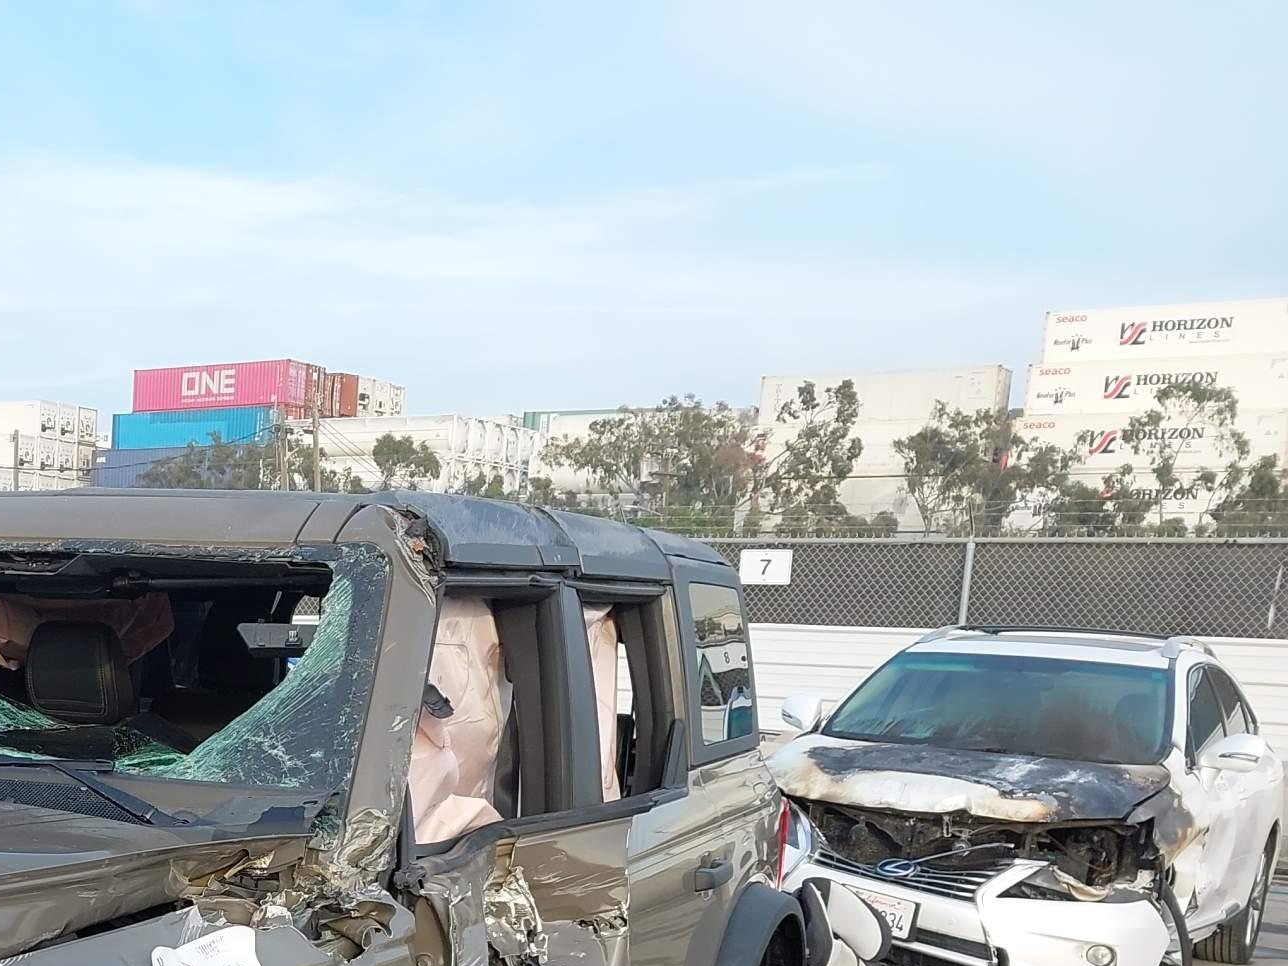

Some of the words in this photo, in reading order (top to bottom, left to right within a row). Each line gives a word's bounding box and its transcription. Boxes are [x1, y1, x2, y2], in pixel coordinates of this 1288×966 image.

[1055, 314, 1088, 324] seaco
[1152, 316, 1234, 332] HORIZON
[1149, 330, 1220, 341] LINES
[1039, 367, 1072, 376] seaco
[181, 369, 235, 396] ONE
[1135, 371, 1218, 386] HORIZON
[1023, 420, 1056, 430] seaco
[759, 558, 773, 576] 7
